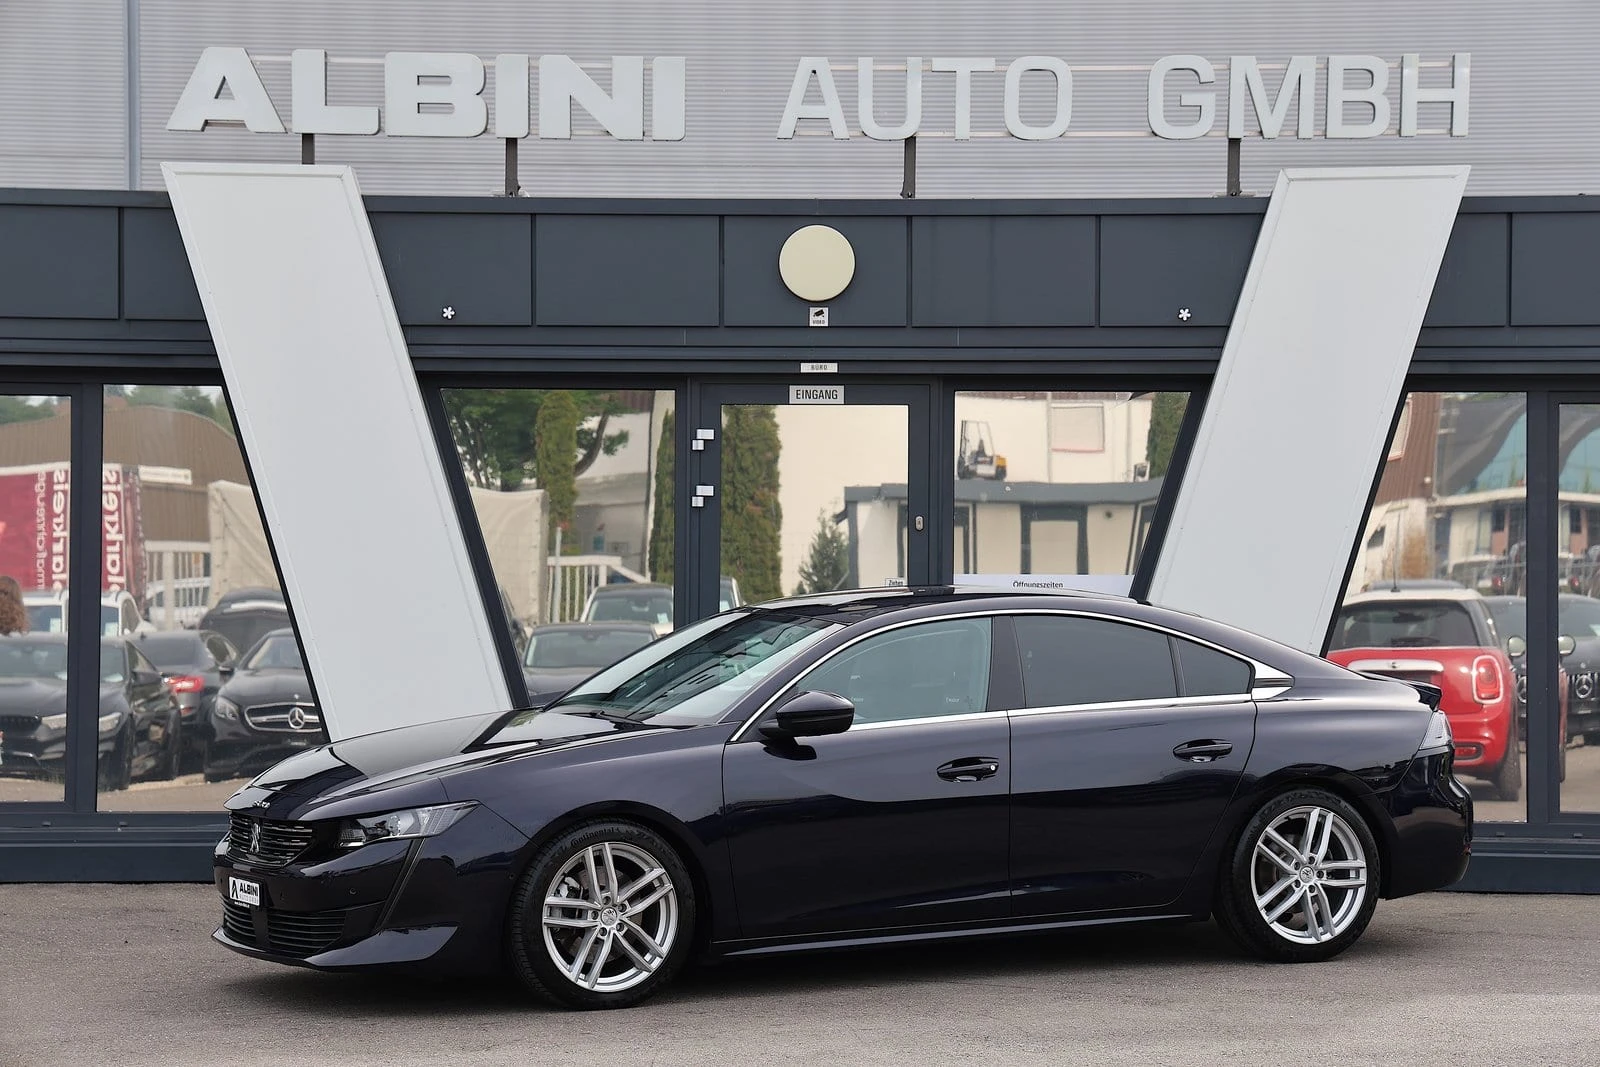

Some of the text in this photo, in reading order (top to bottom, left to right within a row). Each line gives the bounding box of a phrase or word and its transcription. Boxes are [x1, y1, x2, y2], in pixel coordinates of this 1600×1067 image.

[166, 47, 1471, 141] ALBINI AUTO GMBH
[796, 389, 838, 400] EINGANG
[240, 882, 258, 896] ALBINI
